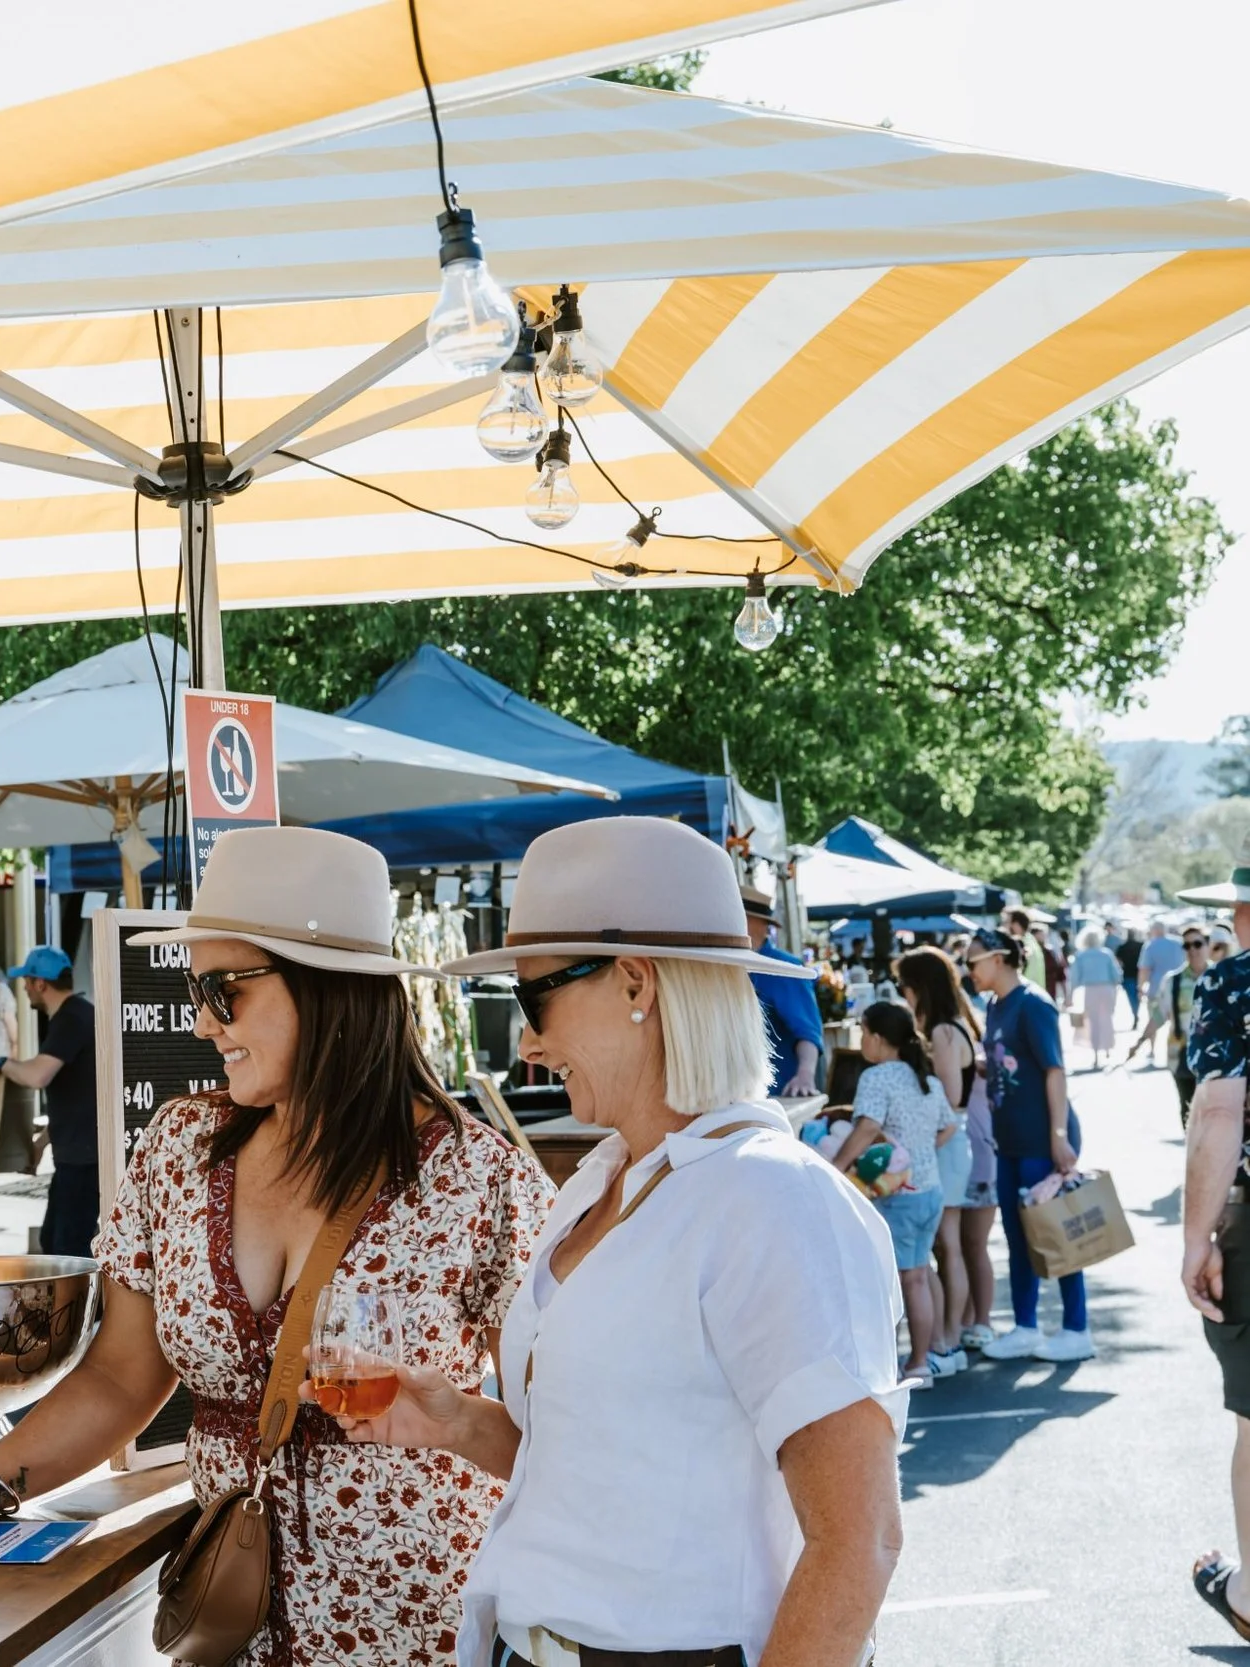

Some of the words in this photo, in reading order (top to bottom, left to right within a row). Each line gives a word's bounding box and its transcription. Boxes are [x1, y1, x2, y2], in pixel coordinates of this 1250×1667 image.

[210, 700, 239, 715] UNDER
[240, 703, 250, 716] 18
[197, 827, 210, 841] No
[122, 1003, 165, 1032] PRICE
[170, 1003, 197, 1033] LIS
[123, 1080, 154, 1111] $40
